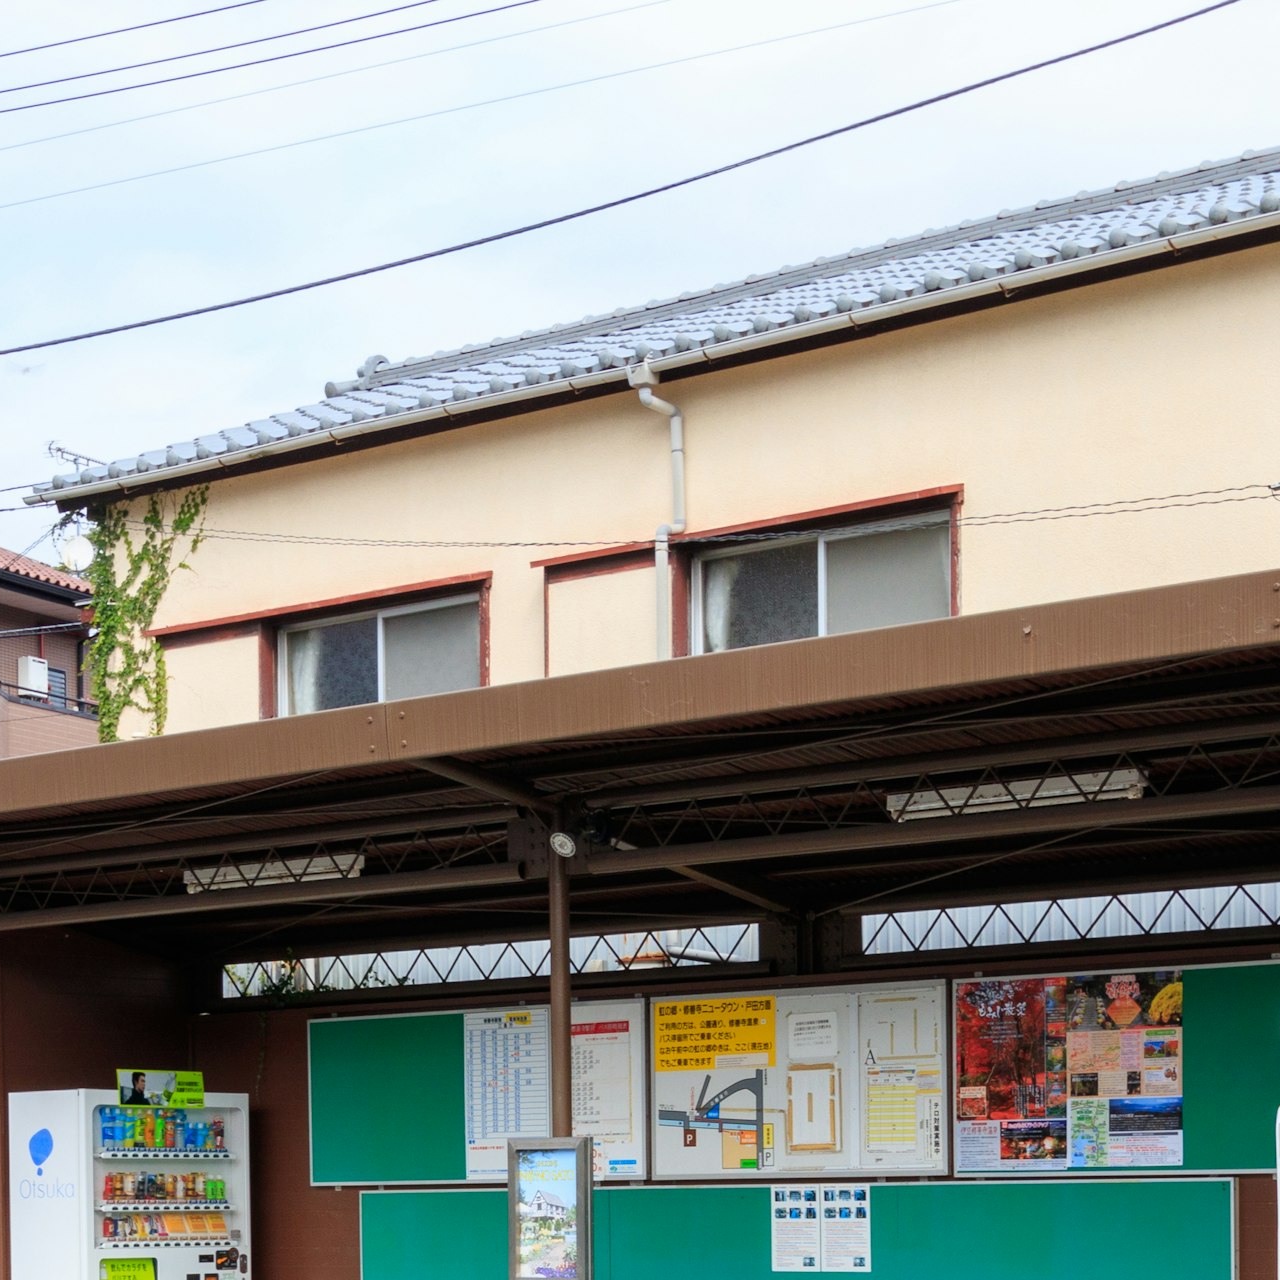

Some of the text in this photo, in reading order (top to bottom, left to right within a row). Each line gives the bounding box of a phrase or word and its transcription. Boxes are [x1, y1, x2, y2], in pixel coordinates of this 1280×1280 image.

[659, 1000, 771, 1016] 虹の郷・修善寺ニュータウン・戸田方面
[686, 1134, 693, 1145] P
[765, 1152, 772, 1162] P
[19, 1176, 75, 1199] Otsuka
